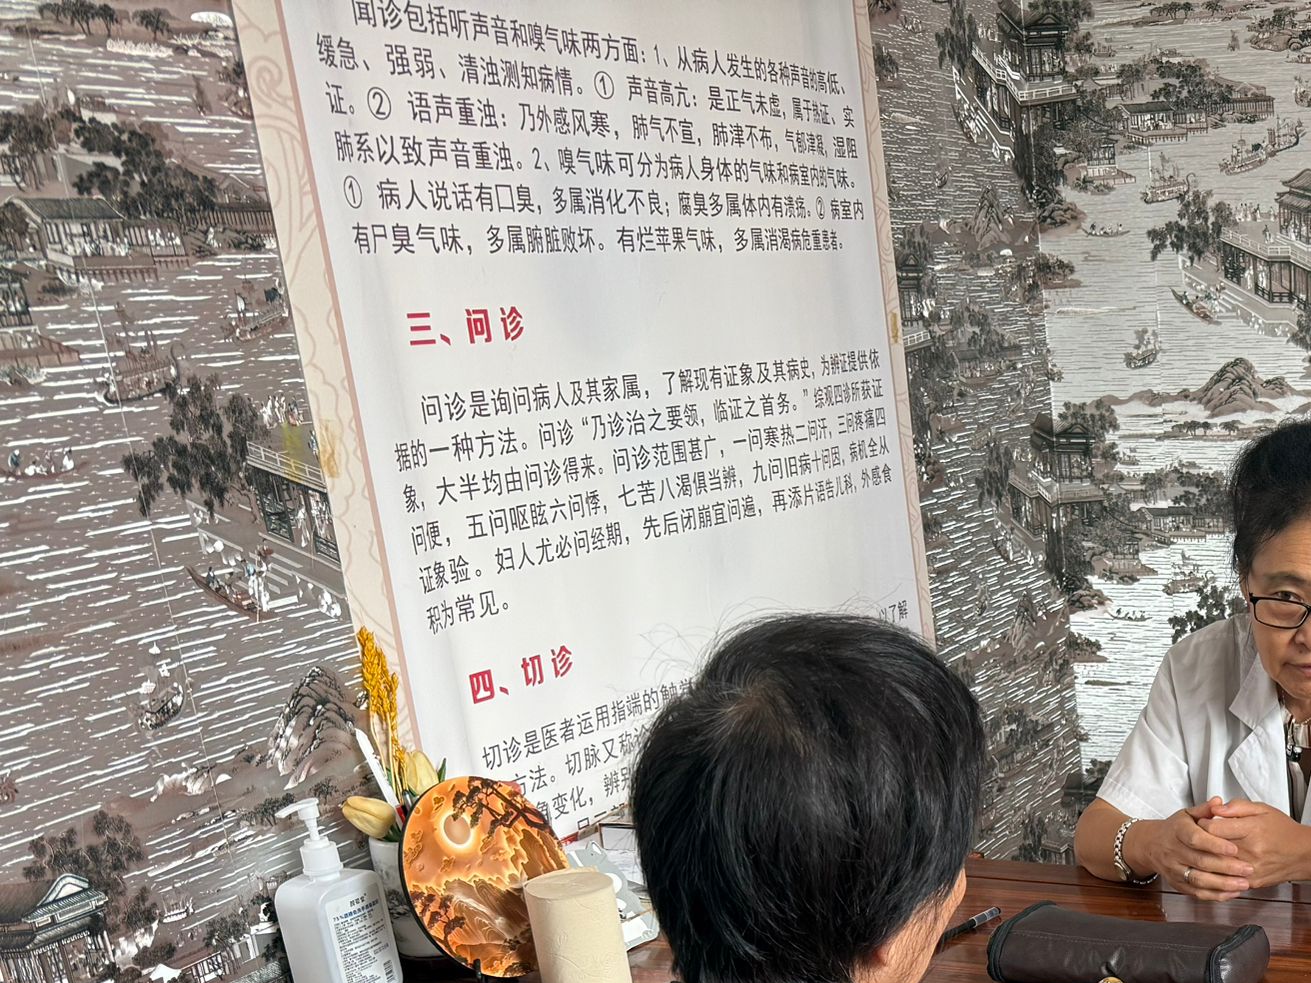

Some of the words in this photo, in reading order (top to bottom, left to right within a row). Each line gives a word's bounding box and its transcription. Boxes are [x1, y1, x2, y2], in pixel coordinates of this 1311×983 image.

[406, 306, 524, 346] 三、问诊
[427, 590, 509, 635] 积为常见。
[469, 645, 574, 704] 四、切诊
